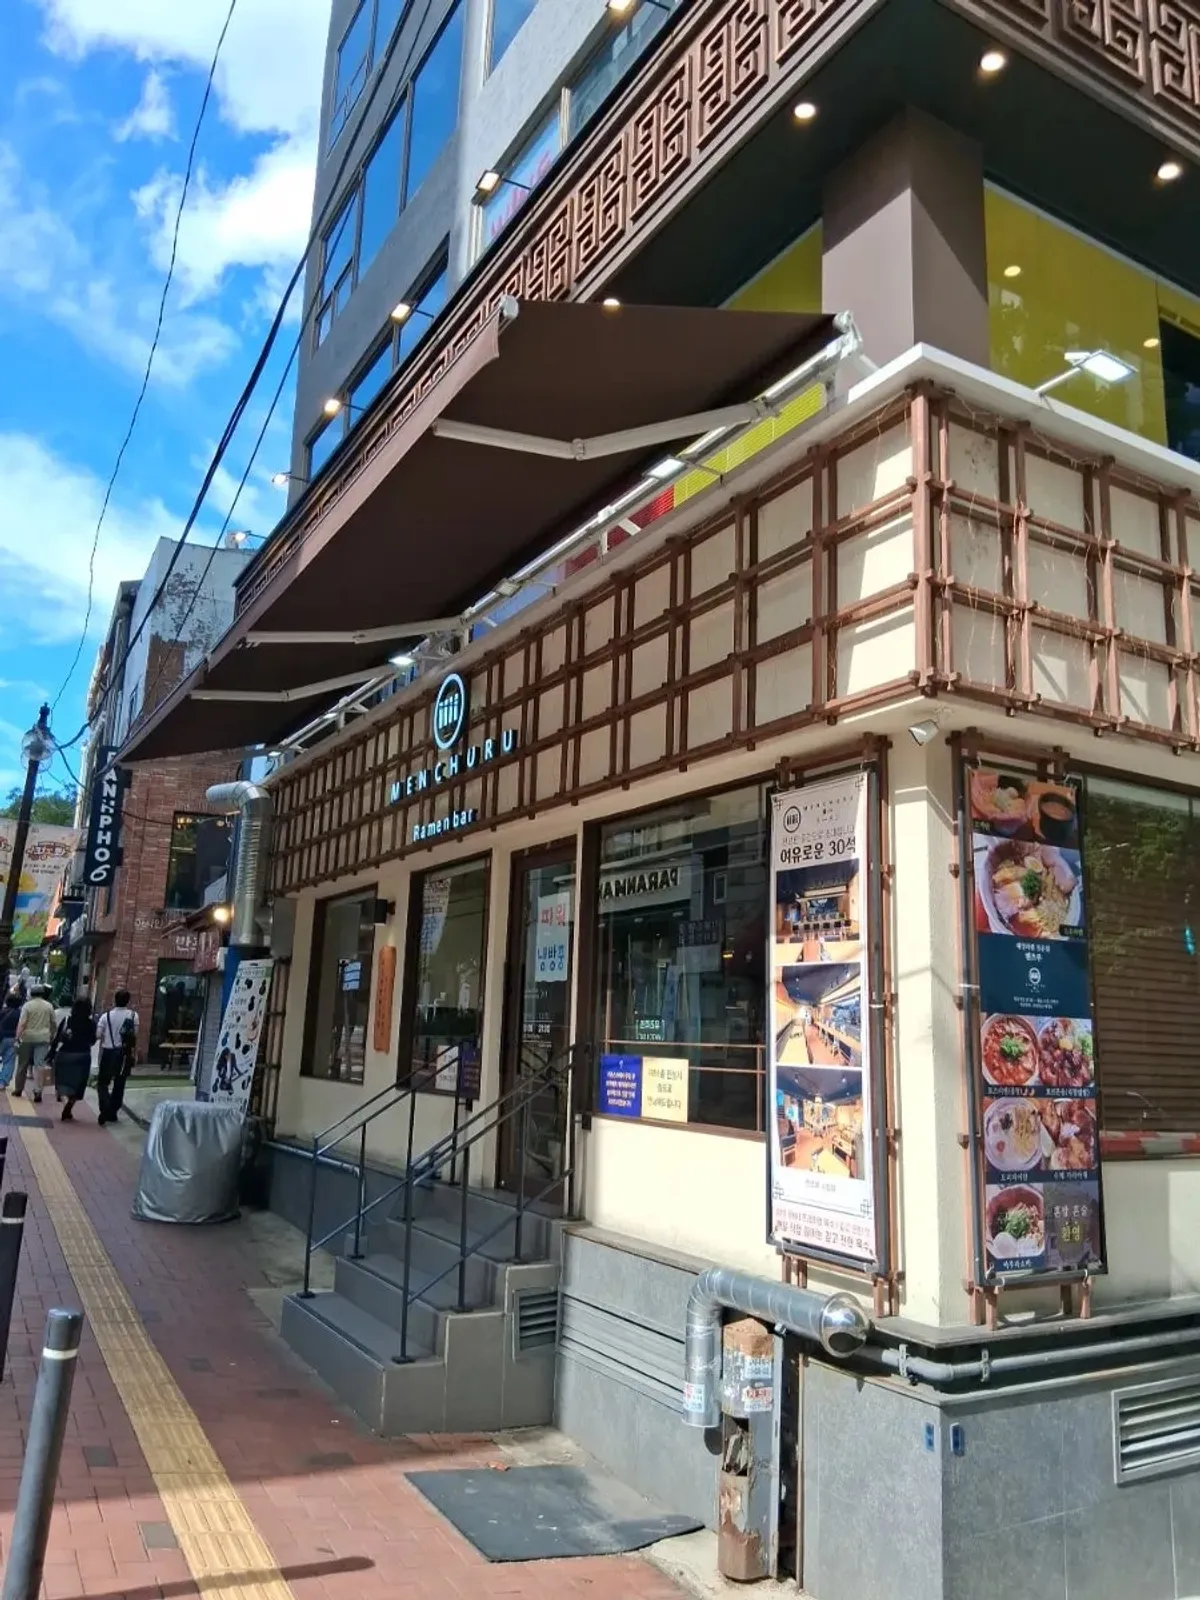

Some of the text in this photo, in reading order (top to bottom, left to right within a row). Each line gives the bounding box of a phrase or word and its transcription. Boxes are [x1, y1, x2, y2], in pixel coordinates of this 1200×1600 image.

[390, 729, 513, 801] MENCHURU
[413, 809, 474, 841] Ramen bar
[780, 836, 857, 864] 여유로운 30석
[537, 944, 565, 972] 냉방중
[1073, 1204, 1088, 1217] 혼술
[1062, 1225, 1081, 1242] 환영
